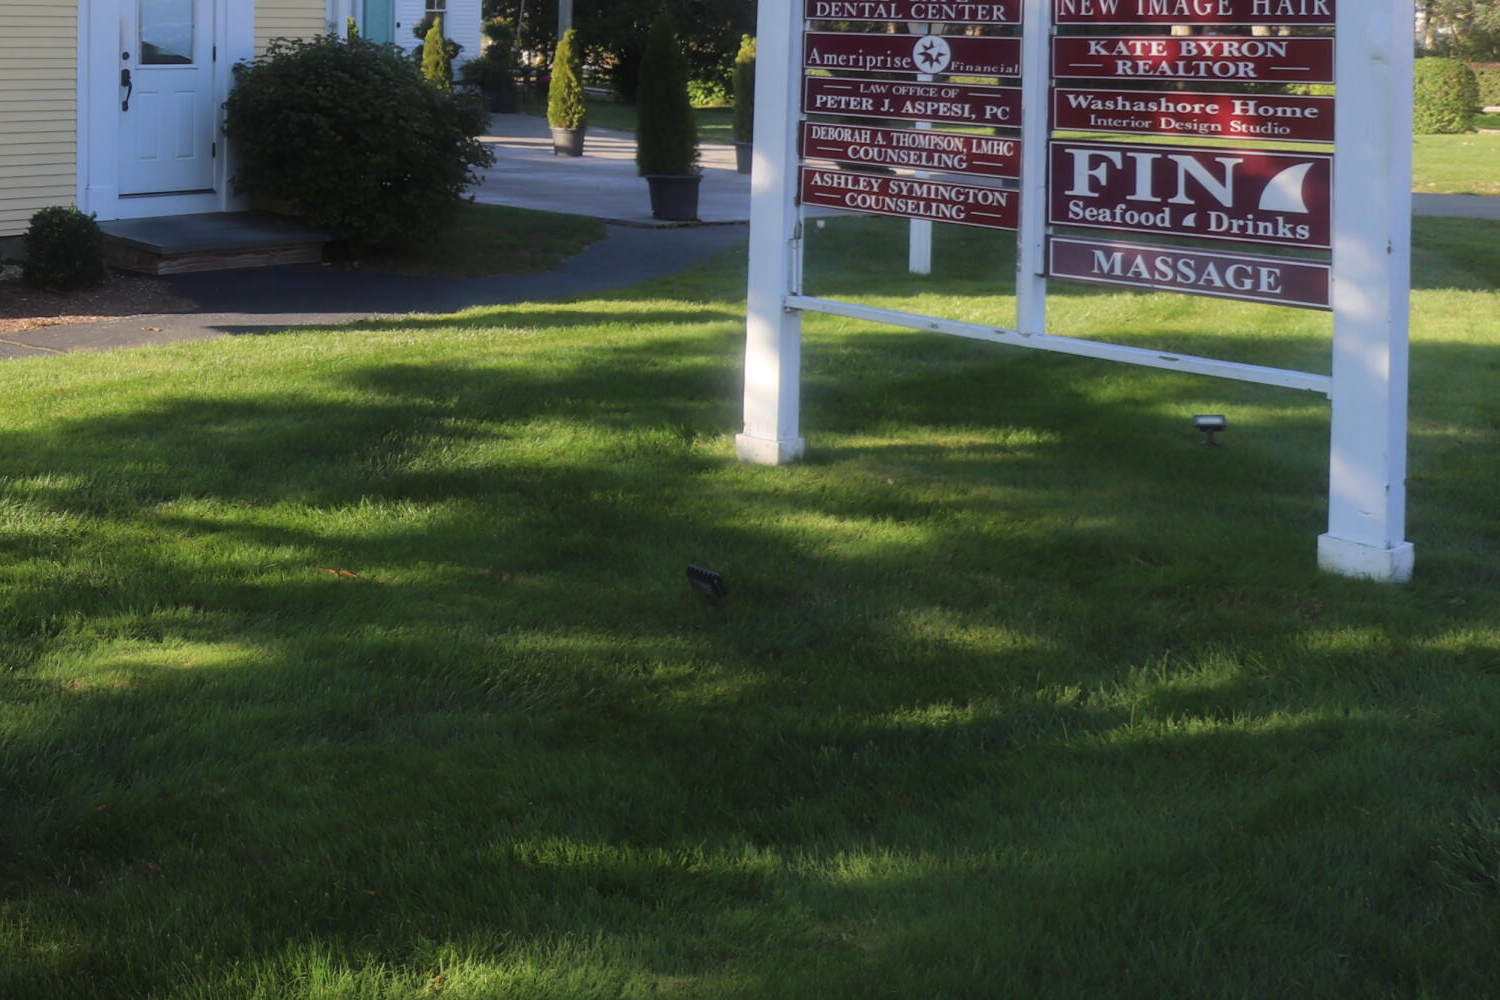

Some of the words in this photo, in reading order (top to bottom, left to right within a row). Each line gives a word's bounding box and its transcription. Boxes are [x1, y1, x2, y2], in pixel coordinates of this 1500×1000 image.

[816, 2, 902, 18] DENTAL
[911, 3, 1007, 21] CENTER
[808, 47, 912, 70] Ameriprise
[1087, 40, 1168, 57] KATE
[1179, 41, 1290, 58] BYRON
[950, 60, 1020, 74] Financial
[1114, 60, 1258, 78] REALTOR
[859, 83, 889, 95] LAW
[892, 85, 938, 97] OFFICE
[941, 87, 960, 98] OF
[815, 95, 873, 111] PETER
[880, 98, 894, 112] J.
[902, 101, 976, 120] ASPESI,
[985, 105, 1010, 121] PC
[1065, 94, 1220, 115] Washashore
[1231, 100, 1319, 119] Home
[1089, 115, 1153, 129] Interior
[1160, 118, 1223, 134] Design
[1229, 120, 1291, 135] Studio
[811, 126, 871, 144] DEBORAH
[874, 130, 886, 145] A.
[890, 132, 968, 155] THOMPSON,
[971, 139, 1014, 156] LMHC
[847, 144, 968, 170] COUNSELING
[810, 172, 883, 191] ASHLEY
[888, 180, 1009, 207] SYMINGTON
[1064, 148, 1244, 208] FIN
[845, 192, 966, 220] COUNSELING
[1068, 200, 1172, 228] Seafood
[1207, 211, 1311, 240] Drinks
[1091, 250, 1283, 295] MASSAGE
